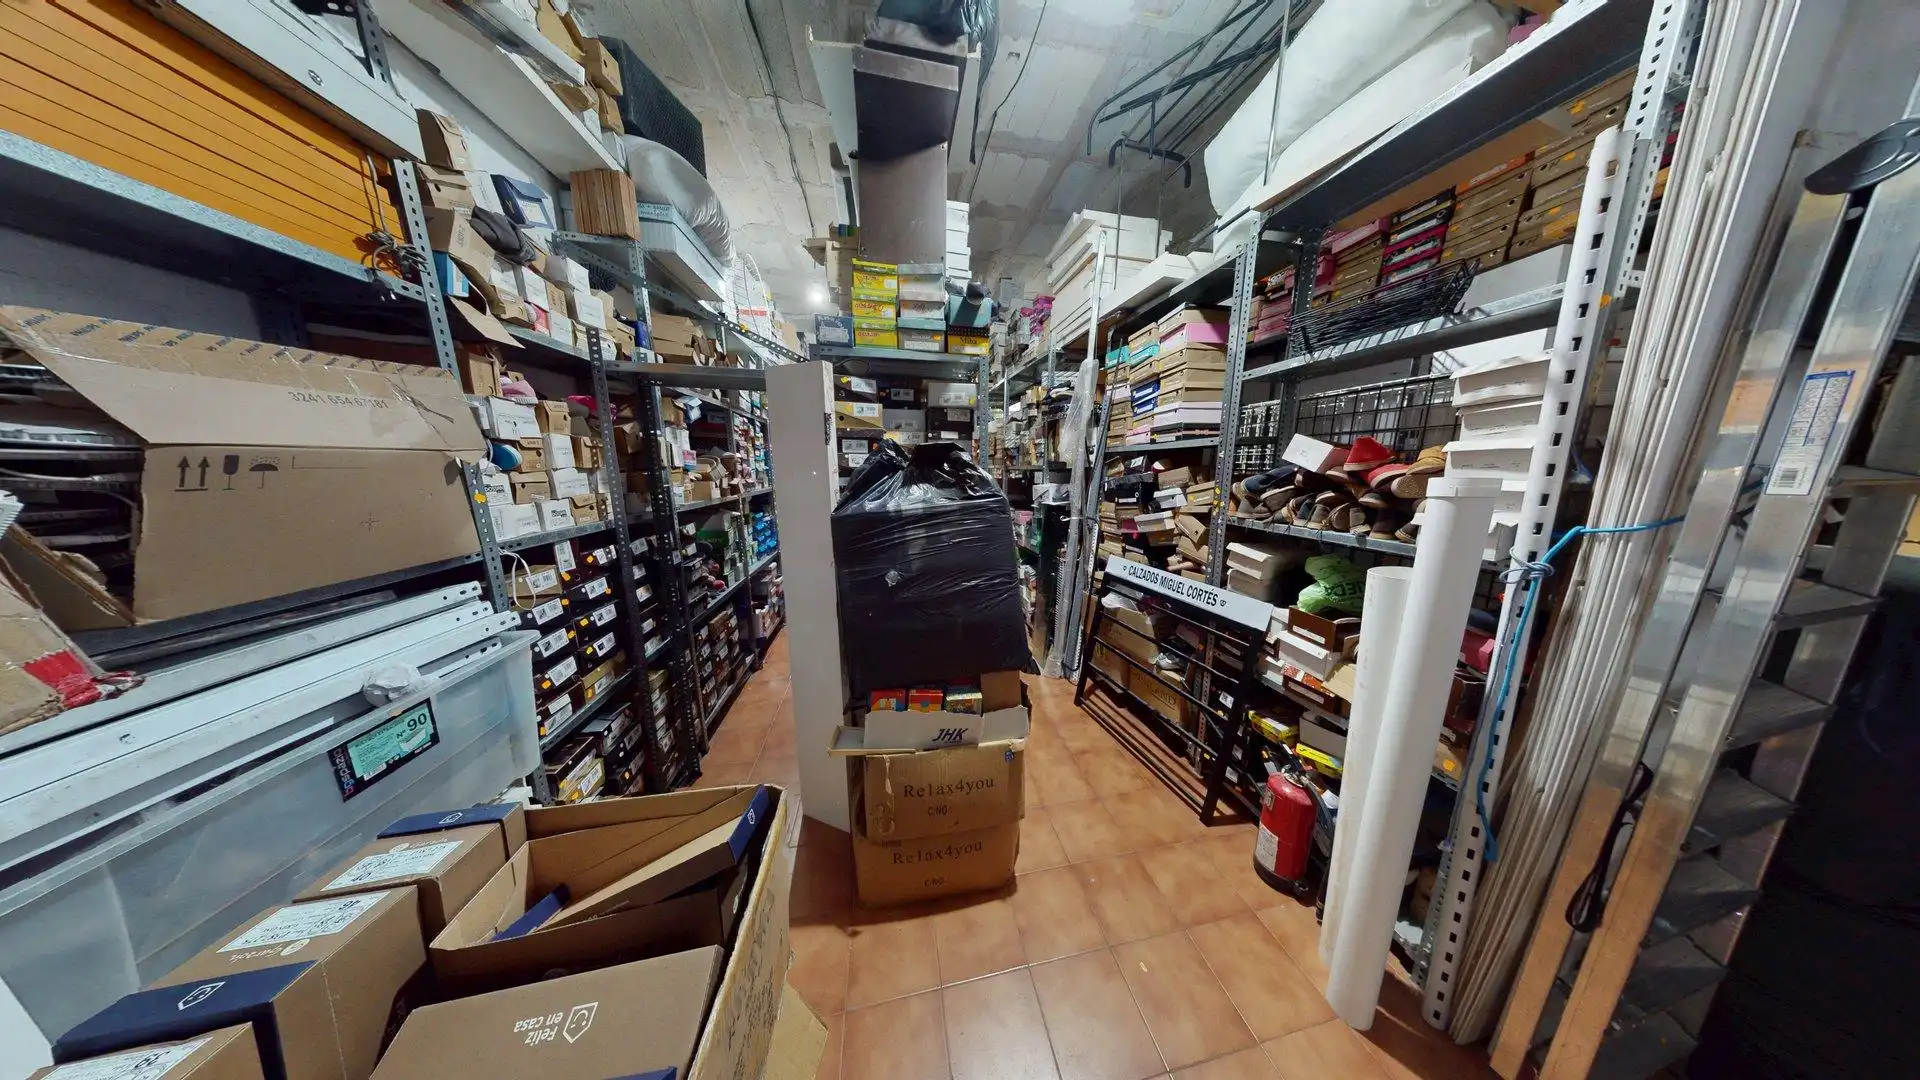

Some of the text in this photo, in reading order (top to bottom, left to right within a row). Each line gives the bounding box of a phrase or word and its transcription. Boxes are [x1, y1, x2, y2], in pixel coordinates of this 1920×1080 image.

[1128, 565, 1219, 607] CALZADOS MIGUEL CORTÉS
[407, 713, 427, 732] 90
[932, 728, 969, 742] JHK
[904, 777, 995, 799] Relax4you
[893, 840, 983, 865] Relax4you
[513, 1011, 564, 1033] en casa
[524, 1026, 558, 1046] Feliz
